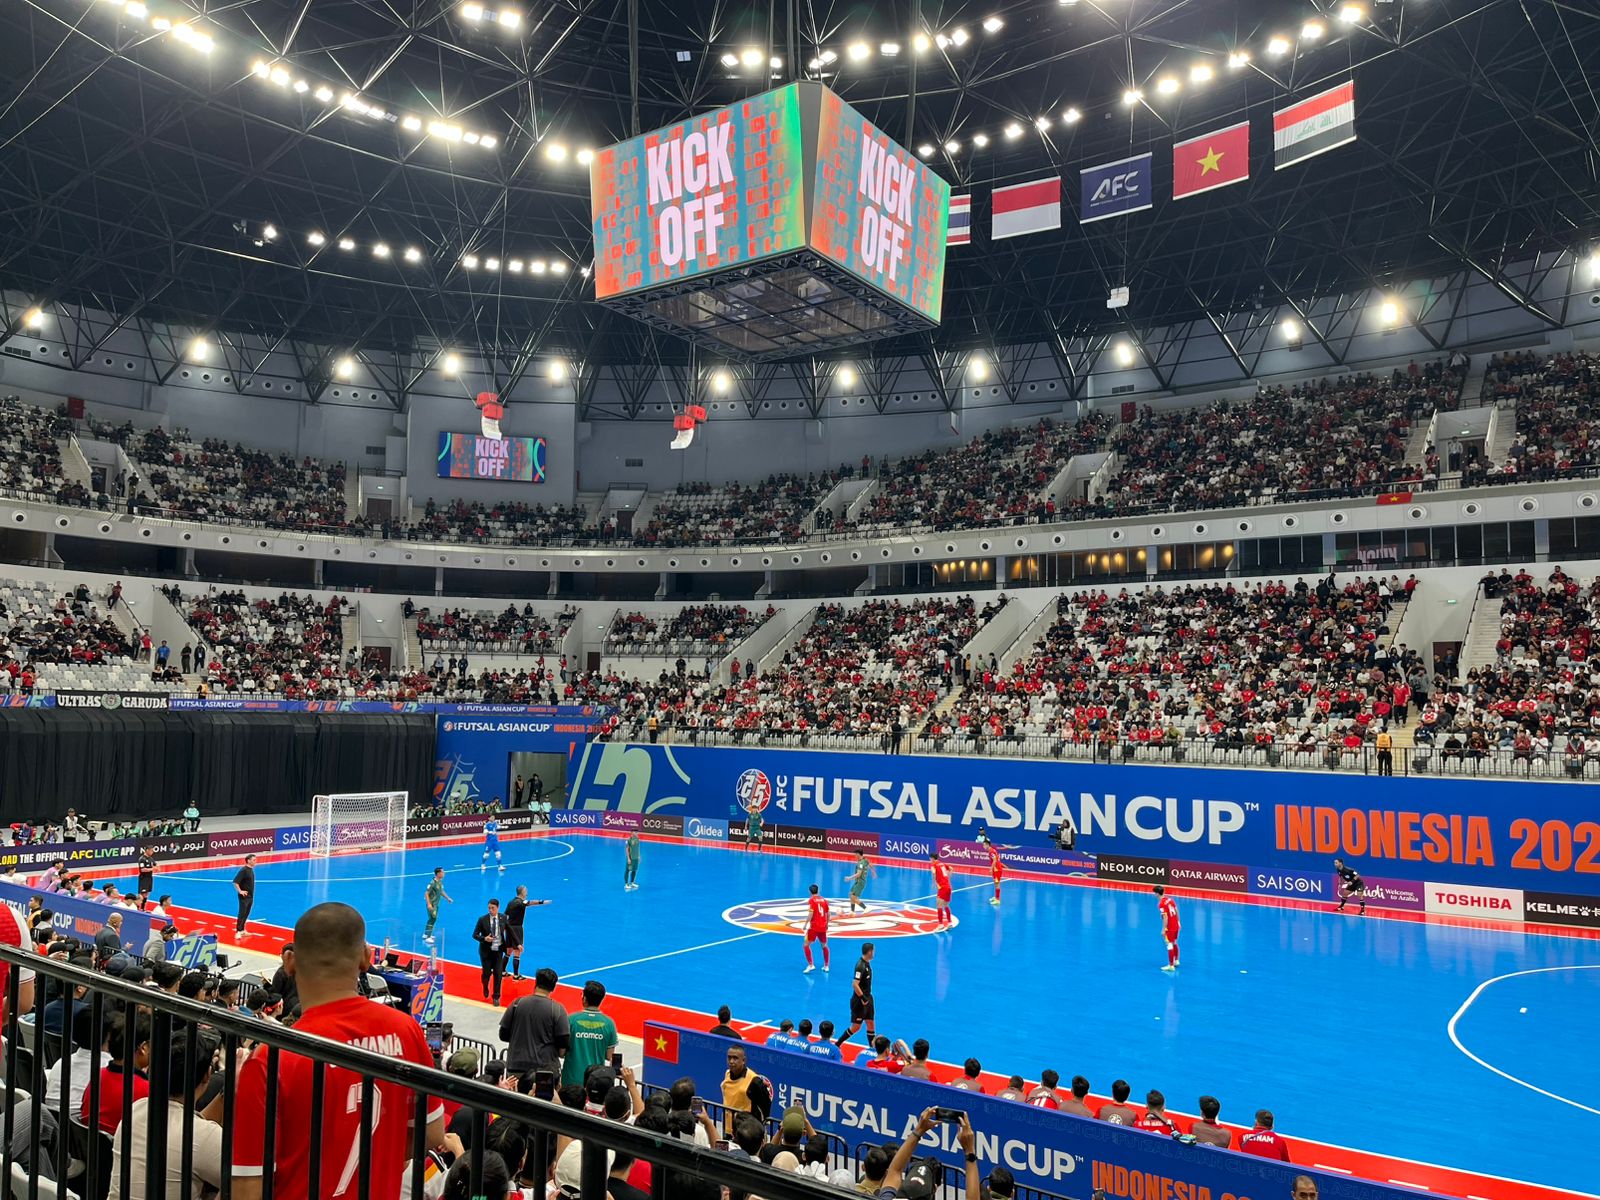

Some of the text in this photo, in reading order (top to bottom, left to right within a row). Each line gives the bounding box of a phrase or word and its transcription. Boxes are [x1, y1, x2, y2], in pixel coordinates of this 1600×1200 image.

[647, 121, 735, 206] KICK
[859, 132, 916, 228] KICK
[1090, 170, 1139, 202] AFC
[659, 191, 725, 267] OFF
[861, 205, 905, 282] OFF
[475, 438, 509, 458] KICK
[478, 458, 505, 477] OFF
[56, 694, 168, 709] ULTRAS GARUDA
[457, 722, 496, 732] FUTSAL
[496, 722, 532, 733] ASIAN
[532, 722, 551, 733] CUP
[776, 774, 788, 811] AFC
[793, 776, 952, 825] FUTSAL
[960, 786, 1117, 838] ASIAN
[442, 822, 463, 830] QATAR
[555, 813, 595, 824] SAISON
[688, 818, 723, 837] Midea
[1275, 804, 1495, 867] INDONESIA
[140, 844, 167, 854] NOM
[210, 836, 273, 849] QATAR AIRWAYS
[827, 836, 878, 848] QATAR AIRWAYS
[885, 840, 930, 854] SAISON
[0, 846, 135, 865] OAD THE OFFICIAL AFC LIVE APP
[1001, 854, 1025, 862] FUTSAL
[1025, 856, 1046, 864] ASIAN
[1100, 862, 1165, 876] NEOM.COM
[1171, 868, 1245, 884] QATAR AIRWAYS
[1257, 874, 1322, 894] SAISON
[1385, 888, 1414, 896] Welcome
[1435, 892, 1512, 910] TOSHIBA
[1526, 902, 1578, 915] KELME
[575, 1032, 603, 1040] aramco
[790, 1086, 897, 1138] FUTSAL
